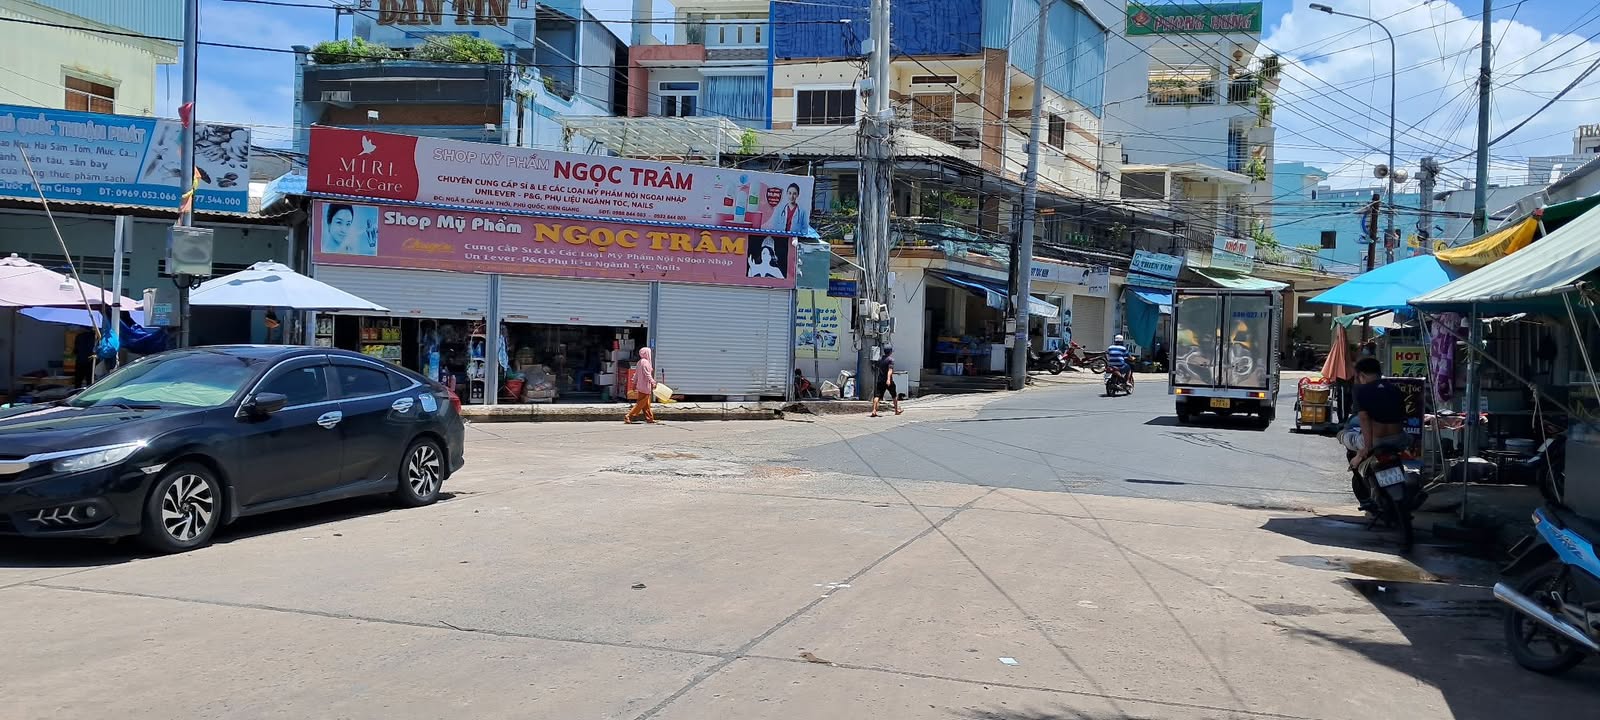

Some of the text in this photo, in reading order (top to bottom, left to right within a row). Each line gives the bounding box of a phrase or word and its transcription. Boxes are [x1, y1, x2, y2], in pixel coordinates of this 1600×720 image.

[57, 120, 106, 142] THUẬN
[108, 125, 146, 144] PHÁT
[90, 160, 108, 170] bay
[433, 148, 477, 164] SHOP
[481, 151, 505, 167] MỸ
[553, 160, 623, 187] NGỌC
[630, 166, 693, 190] TRÂM
[54, 184, 82, 196] Giang
[116, 188, 177, 201] 0969.053.066
[437, 175, 473, 185] CHUYÊN
[475, 178, 499, 188] CUNG
[530, 183, 536, 191] &
[549, 184, 566, 193] CÁC
[475, 188, 516, 199] UNILEVER
[544, 194, 562, 203] PHỤ
[632, 201, 654, 210] NAILS
[383, 211, 746, 255] Shop Mỹ Phẩm NGỌC TRÂM
[464, 243, 494, 252] Cung
[656, 264, 681, 272] Nails
[1396, 352, 1421, 361] HOT
